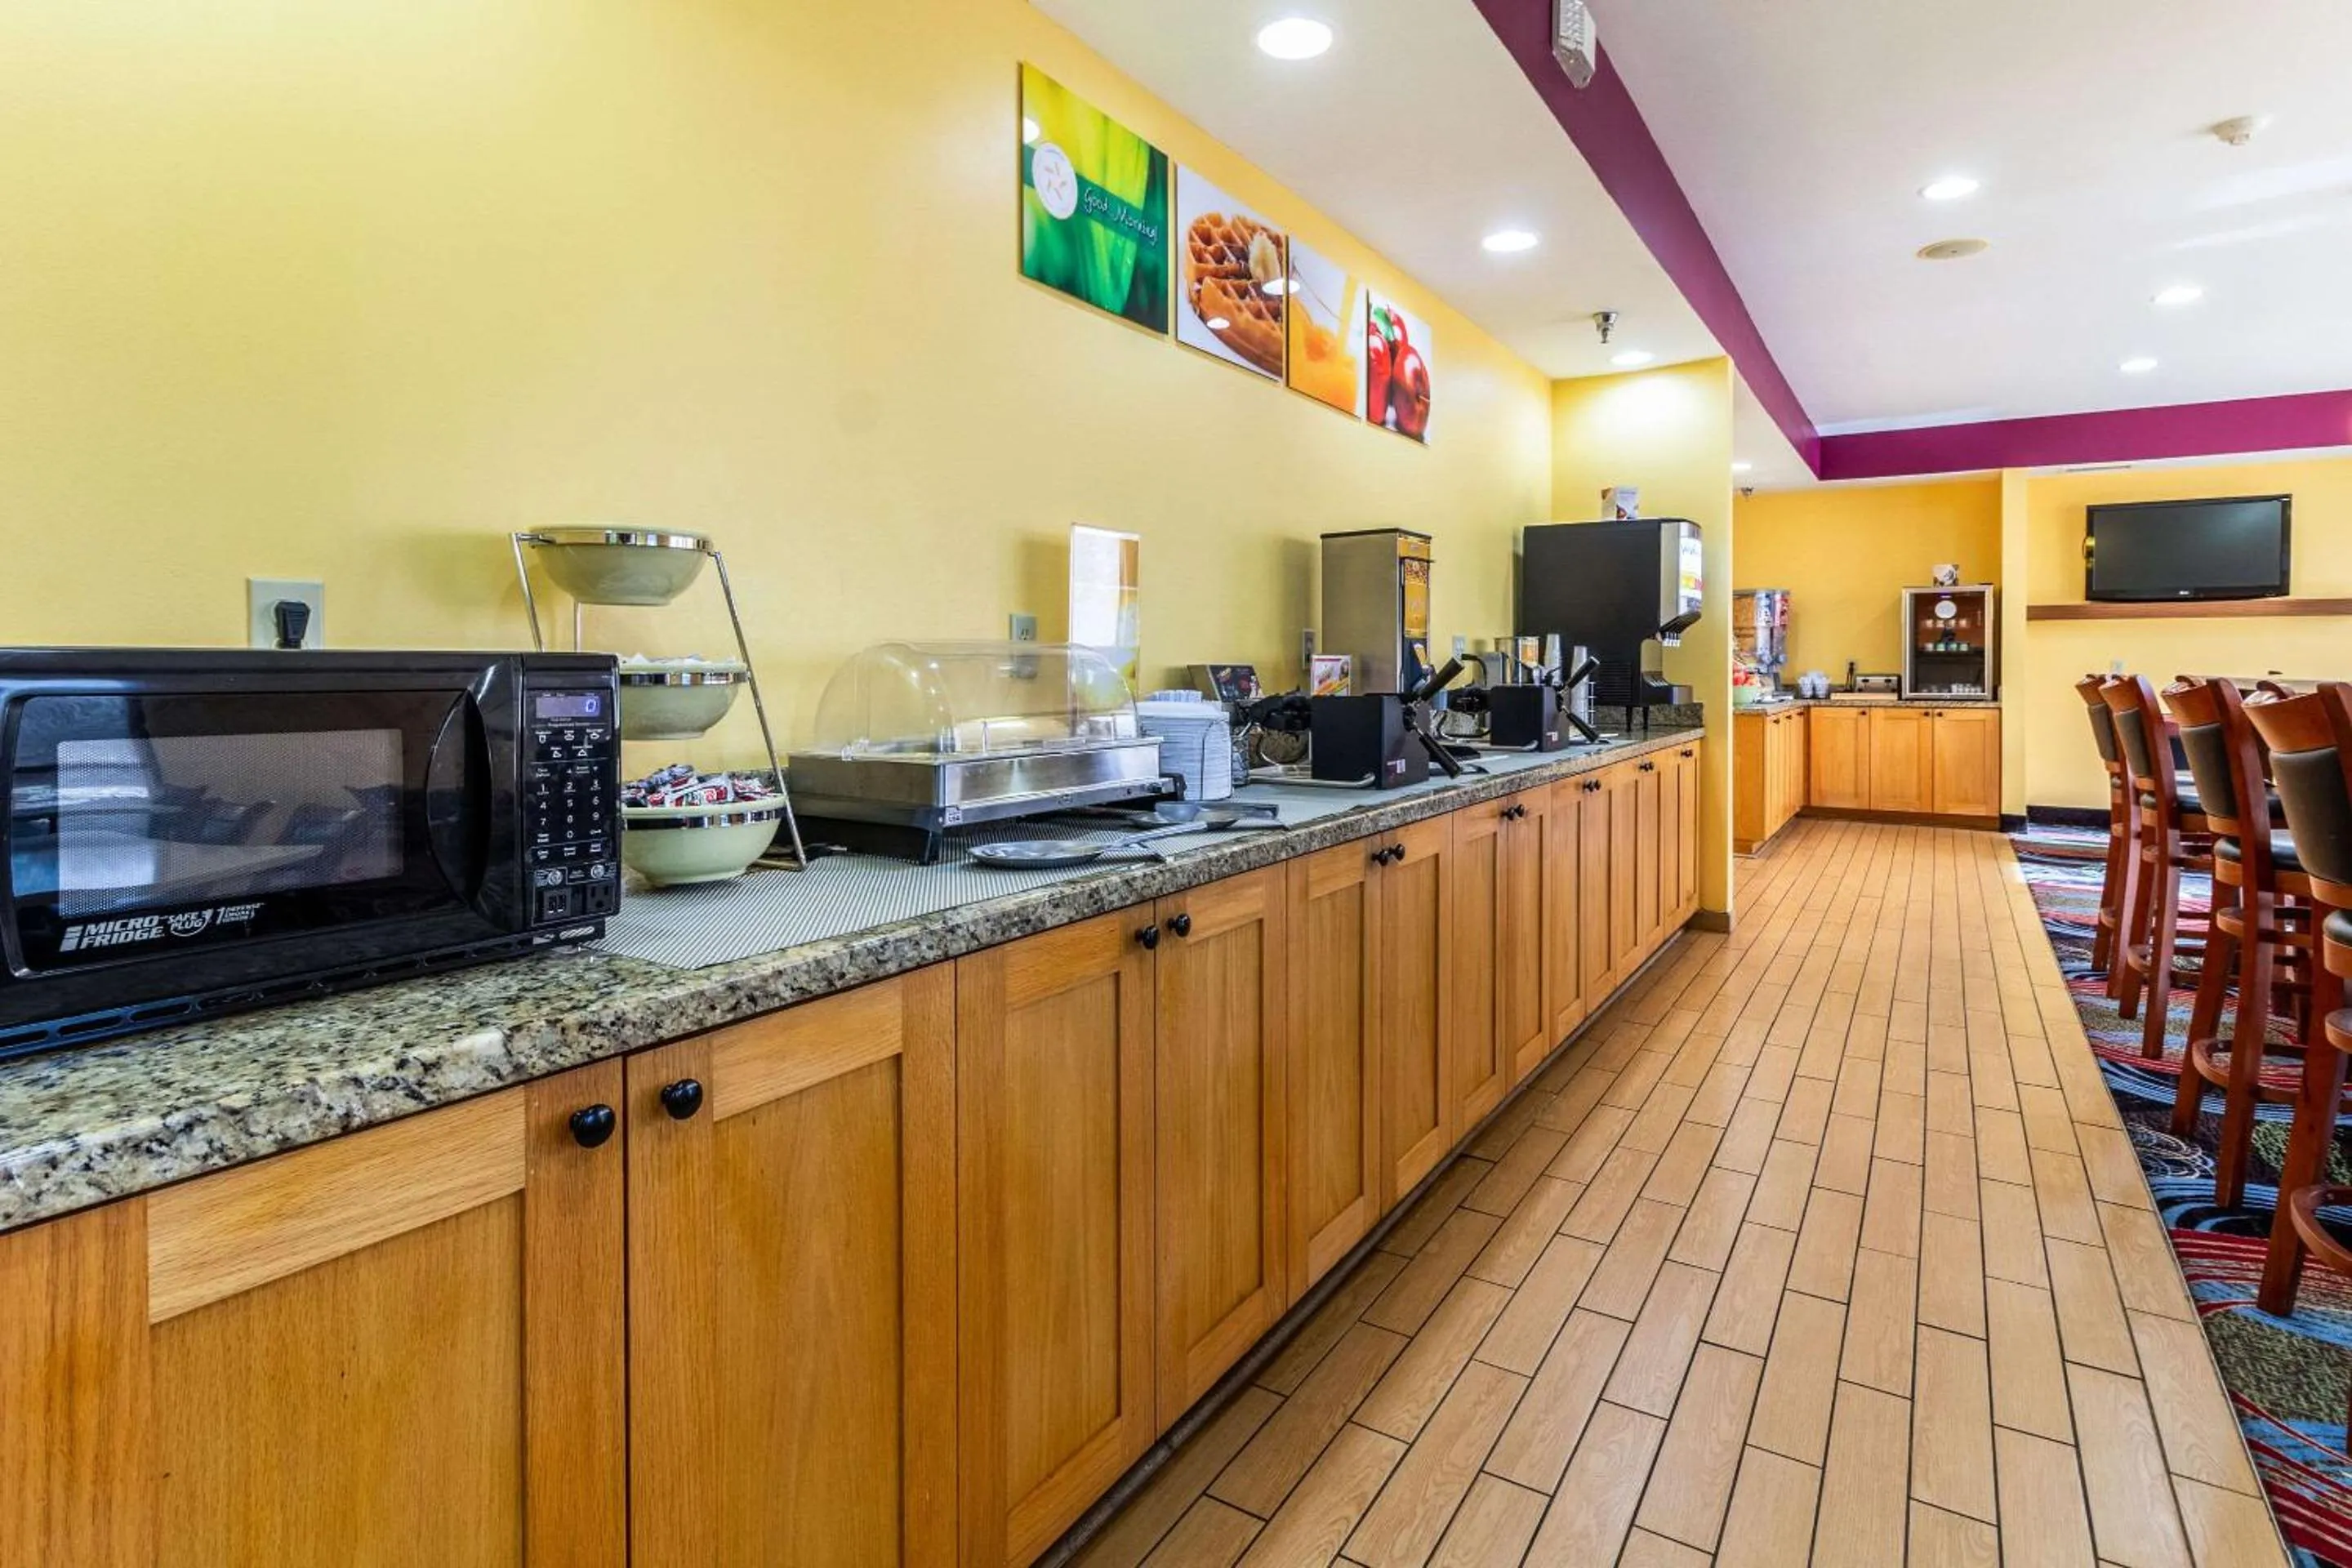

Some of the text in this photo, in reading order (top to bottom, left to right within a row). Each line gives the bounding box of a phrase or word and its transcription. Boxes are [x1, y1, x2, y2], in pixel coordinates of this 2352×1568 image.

[1085, 187, 1107, 213] Good
[84, 915, 160, 936] MICRO
[167, 911, 198, 924] SAFE
[171, 919, 203, 930] PLUG
[80, 926, 164, 949] FRIDGE
